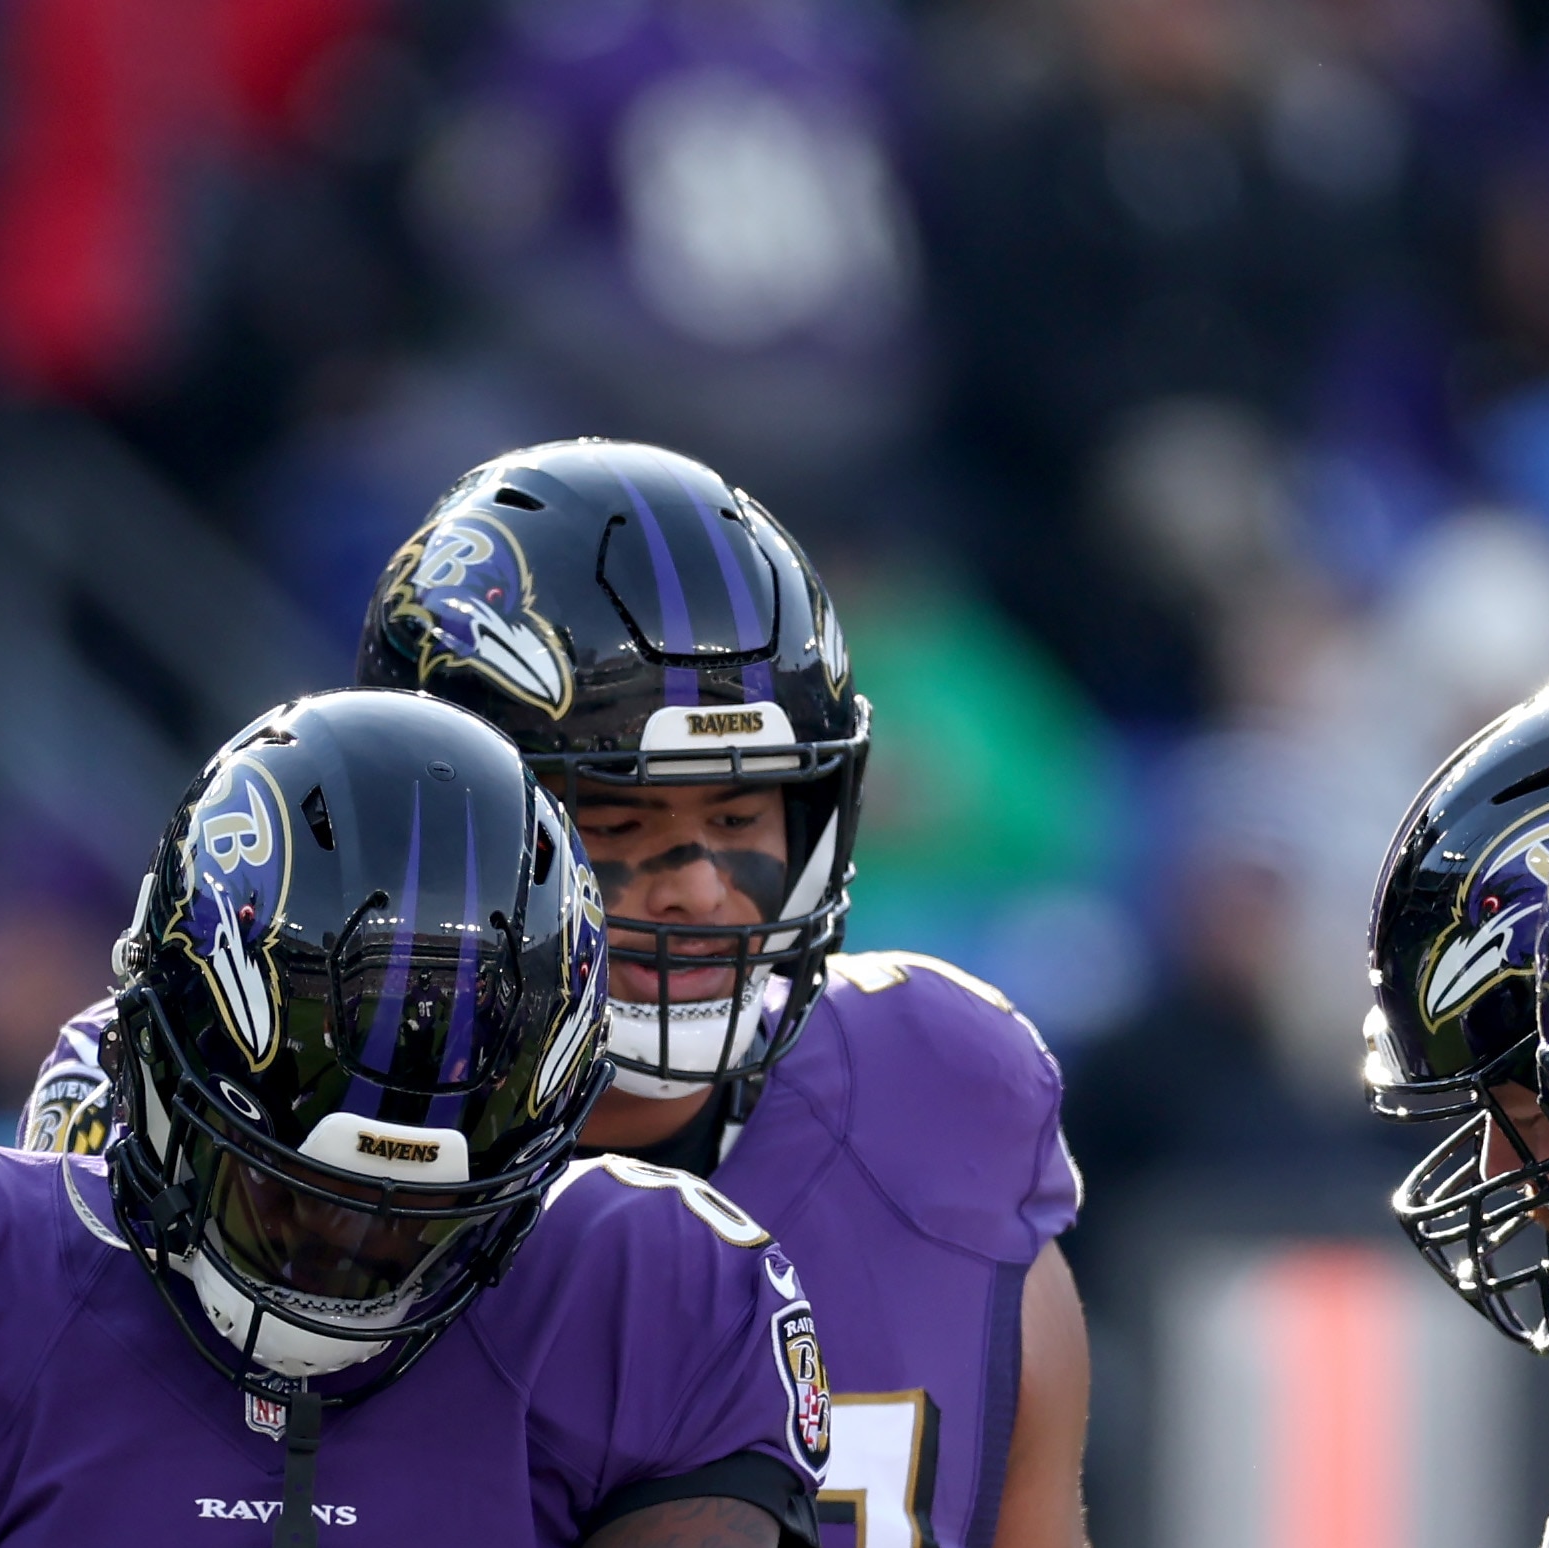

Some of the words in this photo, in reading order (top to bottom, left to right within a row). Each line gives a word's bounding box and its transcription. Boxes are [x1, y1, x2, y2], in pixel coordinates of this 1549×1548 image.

[686, 711, 764, 737] RAVENS
[356, 1130, 440, 1163] RAVENS
[195, 1498, 358, 1526] RAVNS
